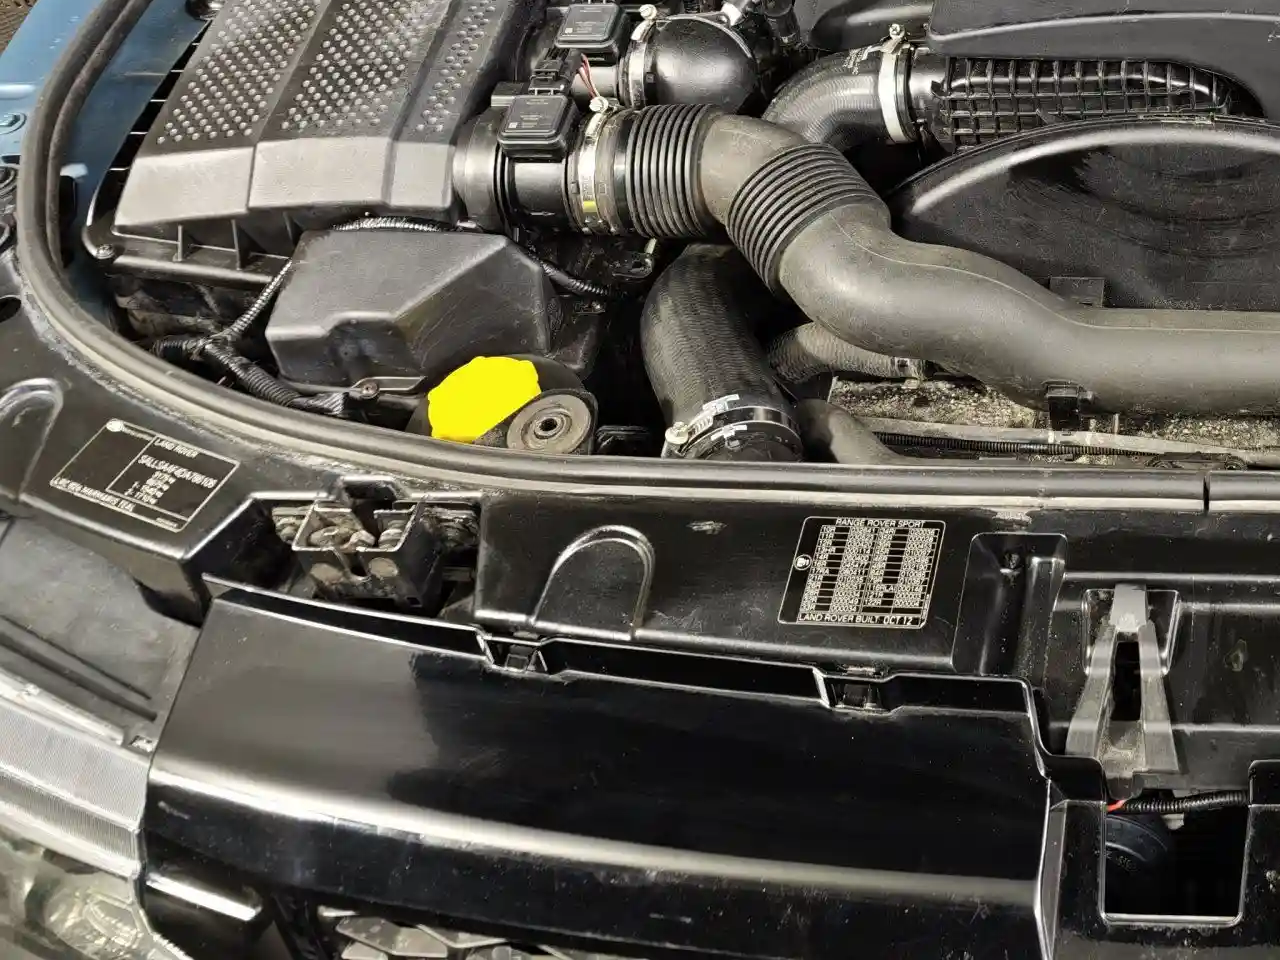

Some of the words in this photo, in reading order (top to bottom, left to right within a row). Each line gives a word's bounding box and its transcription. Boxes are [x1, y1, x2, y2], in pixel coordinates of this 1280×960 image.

[836, 518, 865, 527] RANGE
[799, 613, 822, 621] LAND
[824, 614, 853, 622] ROVER
[856, 615, 879, 623] BUILT
[883, 616, 901, 625] OCT
[904, 616, 912, 626] 12
